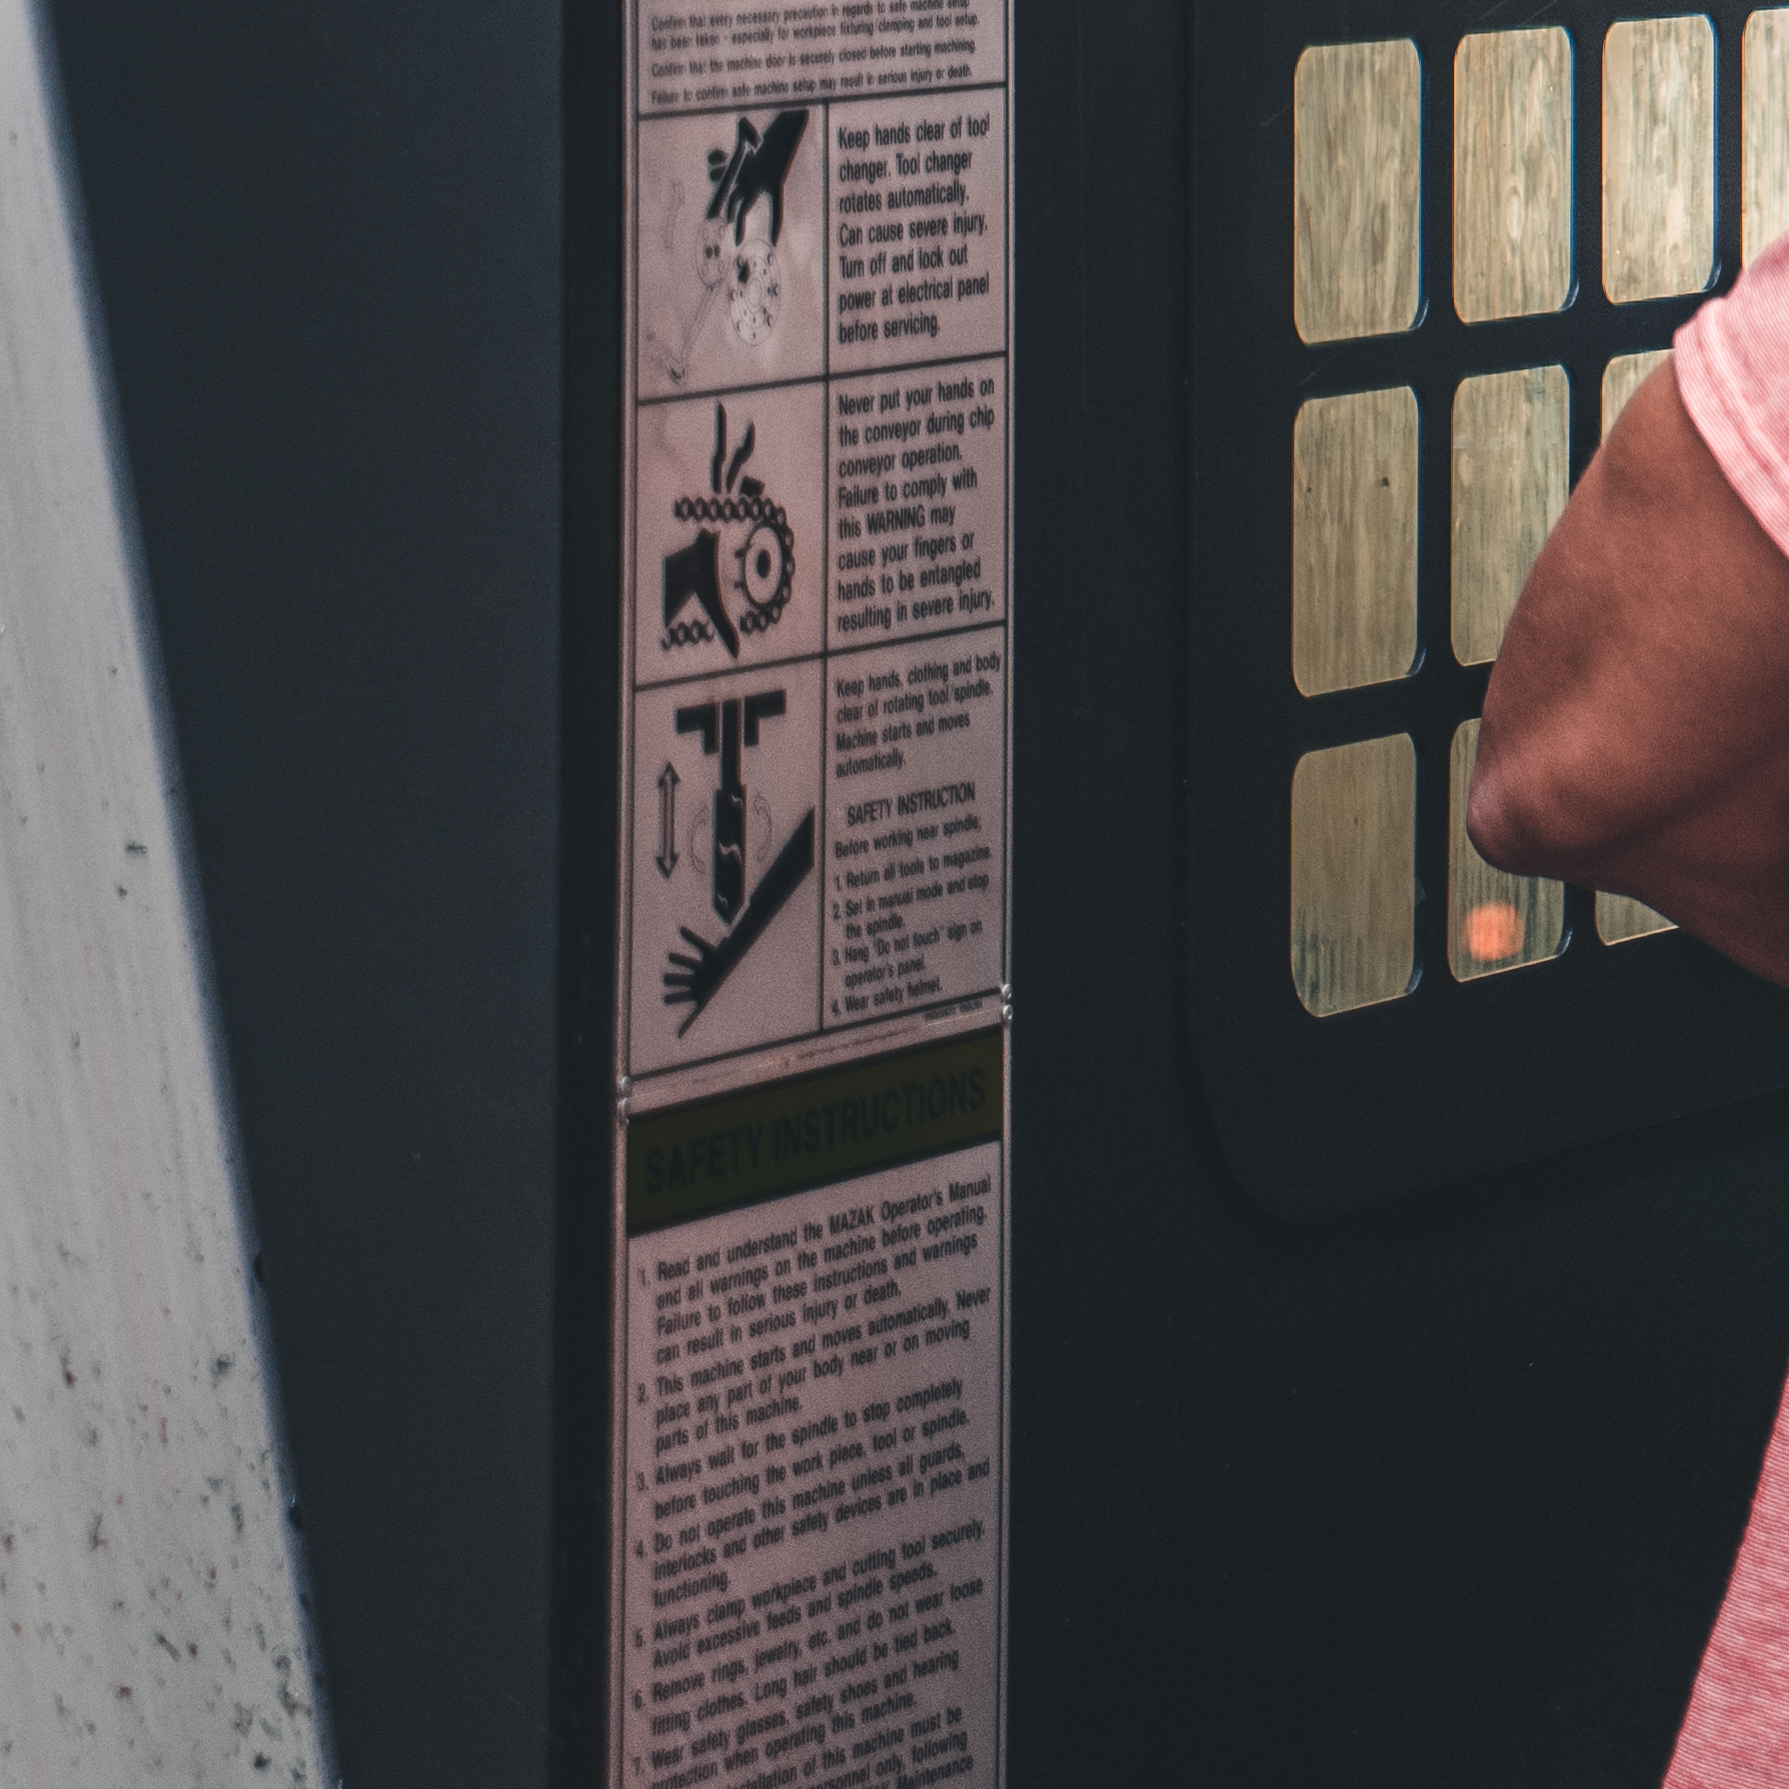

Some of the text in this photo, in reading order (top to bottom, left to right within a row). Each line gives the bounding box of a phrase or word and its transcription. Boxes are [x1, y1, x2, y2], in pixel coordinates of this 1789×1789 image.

[838, 114, 990, 152] Keep hands clear of tool
[839, 151, 972, 184] changer. Tool changer
[839, 179, 968, 214] rotates automatically.
[839, 212, 987, 248] Can cause severe injury.
[839, 244, 968, 279] Turn off and lock out
[838, 273, 989, 315] power at electrical panel
[838, 312, 939, 344] before servicing.
[838, 378, 994, 415] Never put your hands on
[838, 406, 994, 447] the conveyor during chip
[838, 443, 962, 479] conveyor operation.
[838, 468, 977, 508] Failure to comply with
[838, 505, 955, 539] this WARNING may
[838, 533, 974, 571] cause your fingers or
[837, 558, 981, 601] hands to be entangled
[837, 589, 994, 632] resulting in severe injury.
[836, 680, 864, 698] Keep
[908, 663, 949, 685] clothing
[953, 658, 971, 676] and
[836, 679, 992, 724] clear of rotating tool spindle.
[835, 713, 970, 752] Machine starts and moves
[847, 783, 975, 826] SAFETY INSTRUCTION
[645, 1066, 986, 1193] SAFETY INSTRUCTIONS
[657, 1259, 689, 1281] Read
[696, 1251, 720, 1272] and
[727, 1227, 797, 1263] understand
[803, 1223, 823, 1242] the
[829, 1207, 874, 1234] MAZAK
[880, 1190, 943, 1222] Operator's
[949, 1175, 991, 1202] Manual
[656, 1206, 986, 1310] and all warnings on the machine before operating.
[656, 1234, 977, 1336] Failure to follow these instructions and warnings
[656, 1279, 901, 1365] can result in serious injury or death.
[656, 1375, 683, 1396] This
[690, 1359, 744, 1387] machine
[750, 1346, 786, 1371] starts
[792, 1334, 815, 1358] and
[822, 1325, 862, 1349] moves
[956, 1288, 991, 1309] Never
